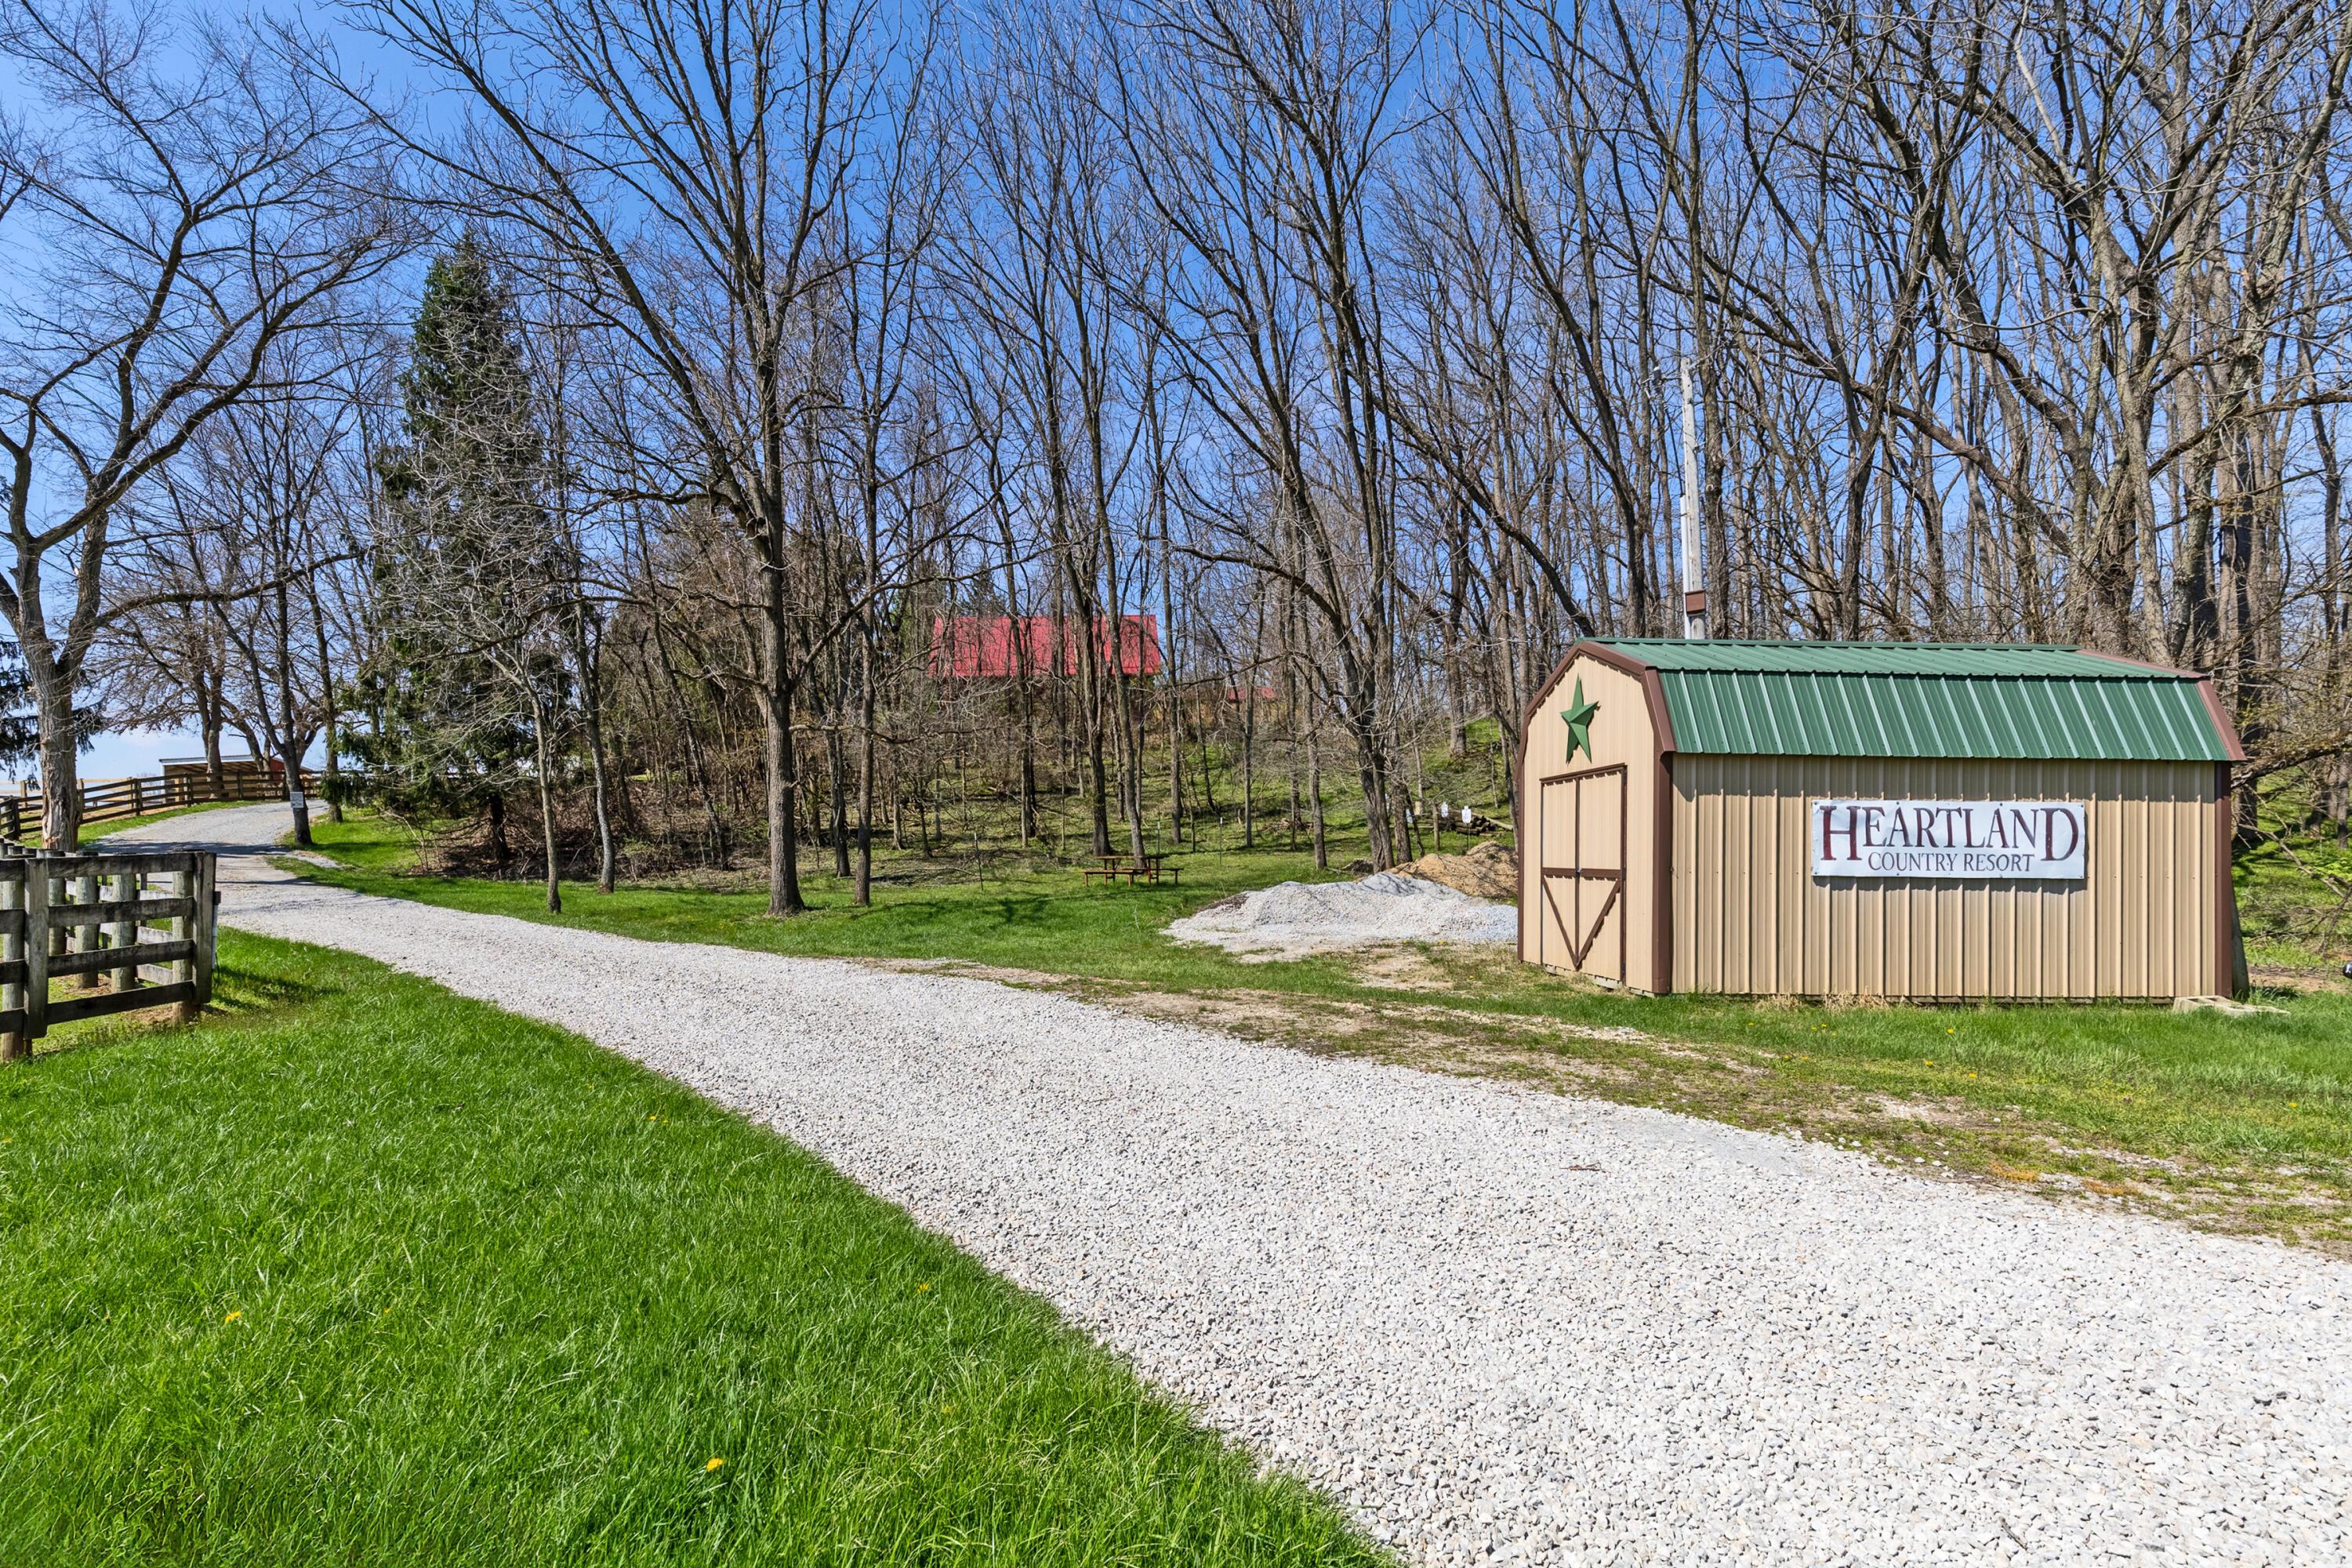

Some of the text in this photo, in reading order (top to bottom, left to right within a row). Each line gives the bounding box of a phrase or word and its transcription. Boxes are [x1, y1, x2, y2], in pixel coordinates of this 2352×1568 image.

[1820, 805, 2079, 862] HEARTLAND
[1868, 851, 2035, 872] COUNTRY RESORT
